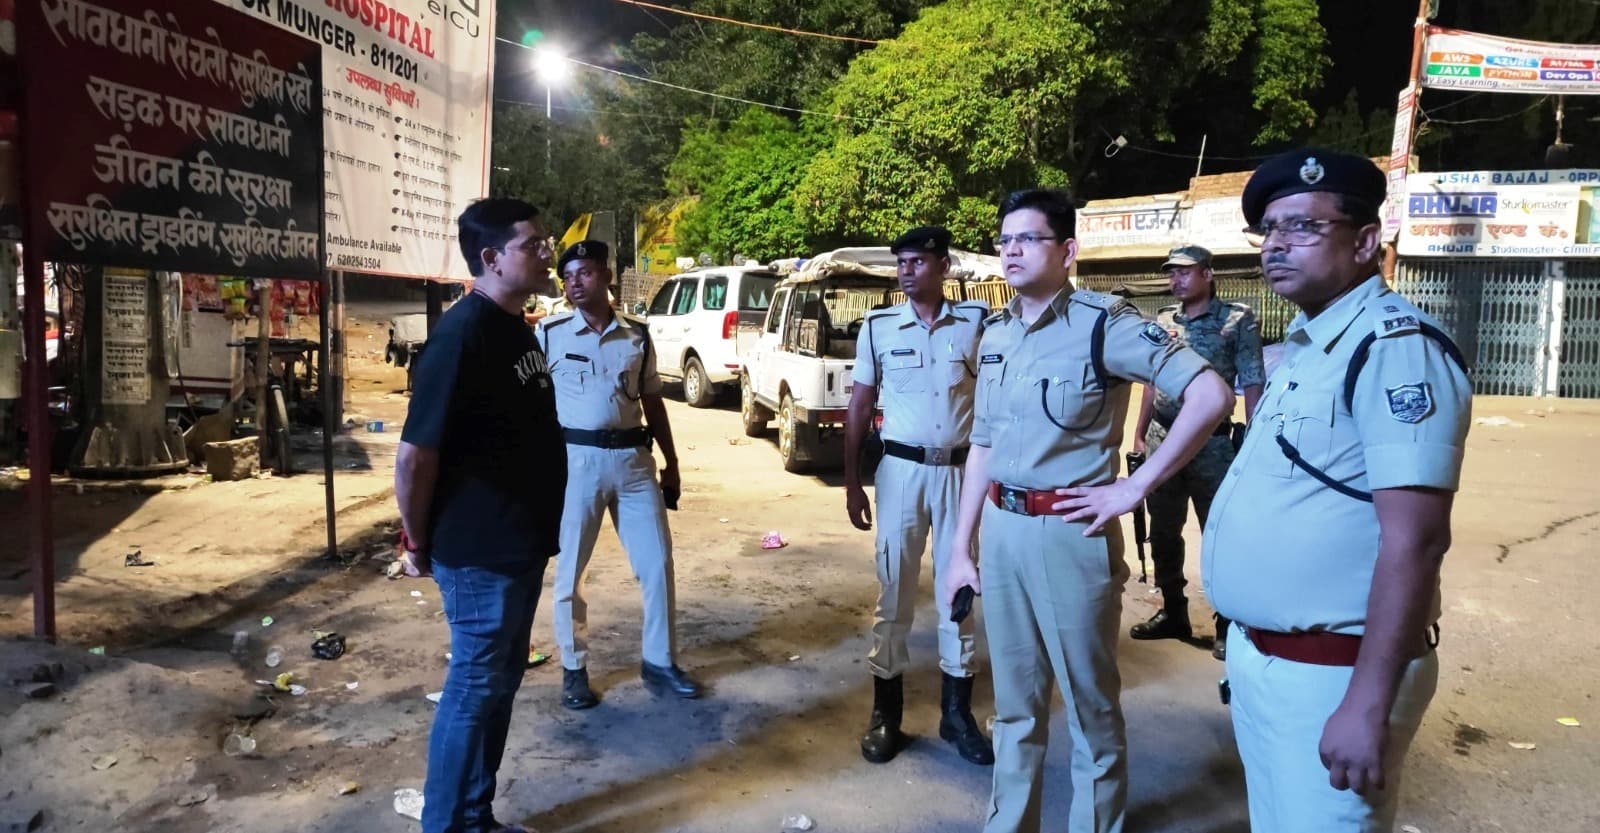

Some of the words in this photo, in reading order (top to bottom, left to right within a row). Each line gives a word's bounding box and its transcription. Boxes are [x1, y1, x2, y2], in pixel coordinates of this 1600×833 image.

[277, 0, 356, 57] MUNGER
[371, 43, 418, 83] 811201
[39, 0, 169, 64] सावधानी
[284, 62, 313, 117] रहो
[1442, 53, 1471, 63] AWS
[1437, 76, 1456, 87] Easy
[1438, 66, 1471, 76] JAVA
[1546, 71, 1565, 80] Dev
[1567, 72, 1590, 81] Ops
[86, 75, 165, 133] सड़क
[165, 94, 207, 142] पर
[205, 113, 292, 158] सावधानी
[92, 134, 184, 192] जीवन
[188, 150, 224, 196] की
[225, 168, 293, 216] सुरक्षा
[1492, 171, 1549, 184] BAJAJ
[1408, 196, 1497, 215] AHUJA
[1501, 198, 1569, 214] Studiomaster
[47, 193, 138, 251] सुरक्षित
[219, 217, 281, 267] सुरक्षित
[279, 218, 319, 261] जीवन
[327, 231, 368, 250] Ambulance
[370, 239, 403, 254] Available
[1428, 244, 1474, 253] AHUJA
[1490, 244, 1554, 254] Studiomaster
